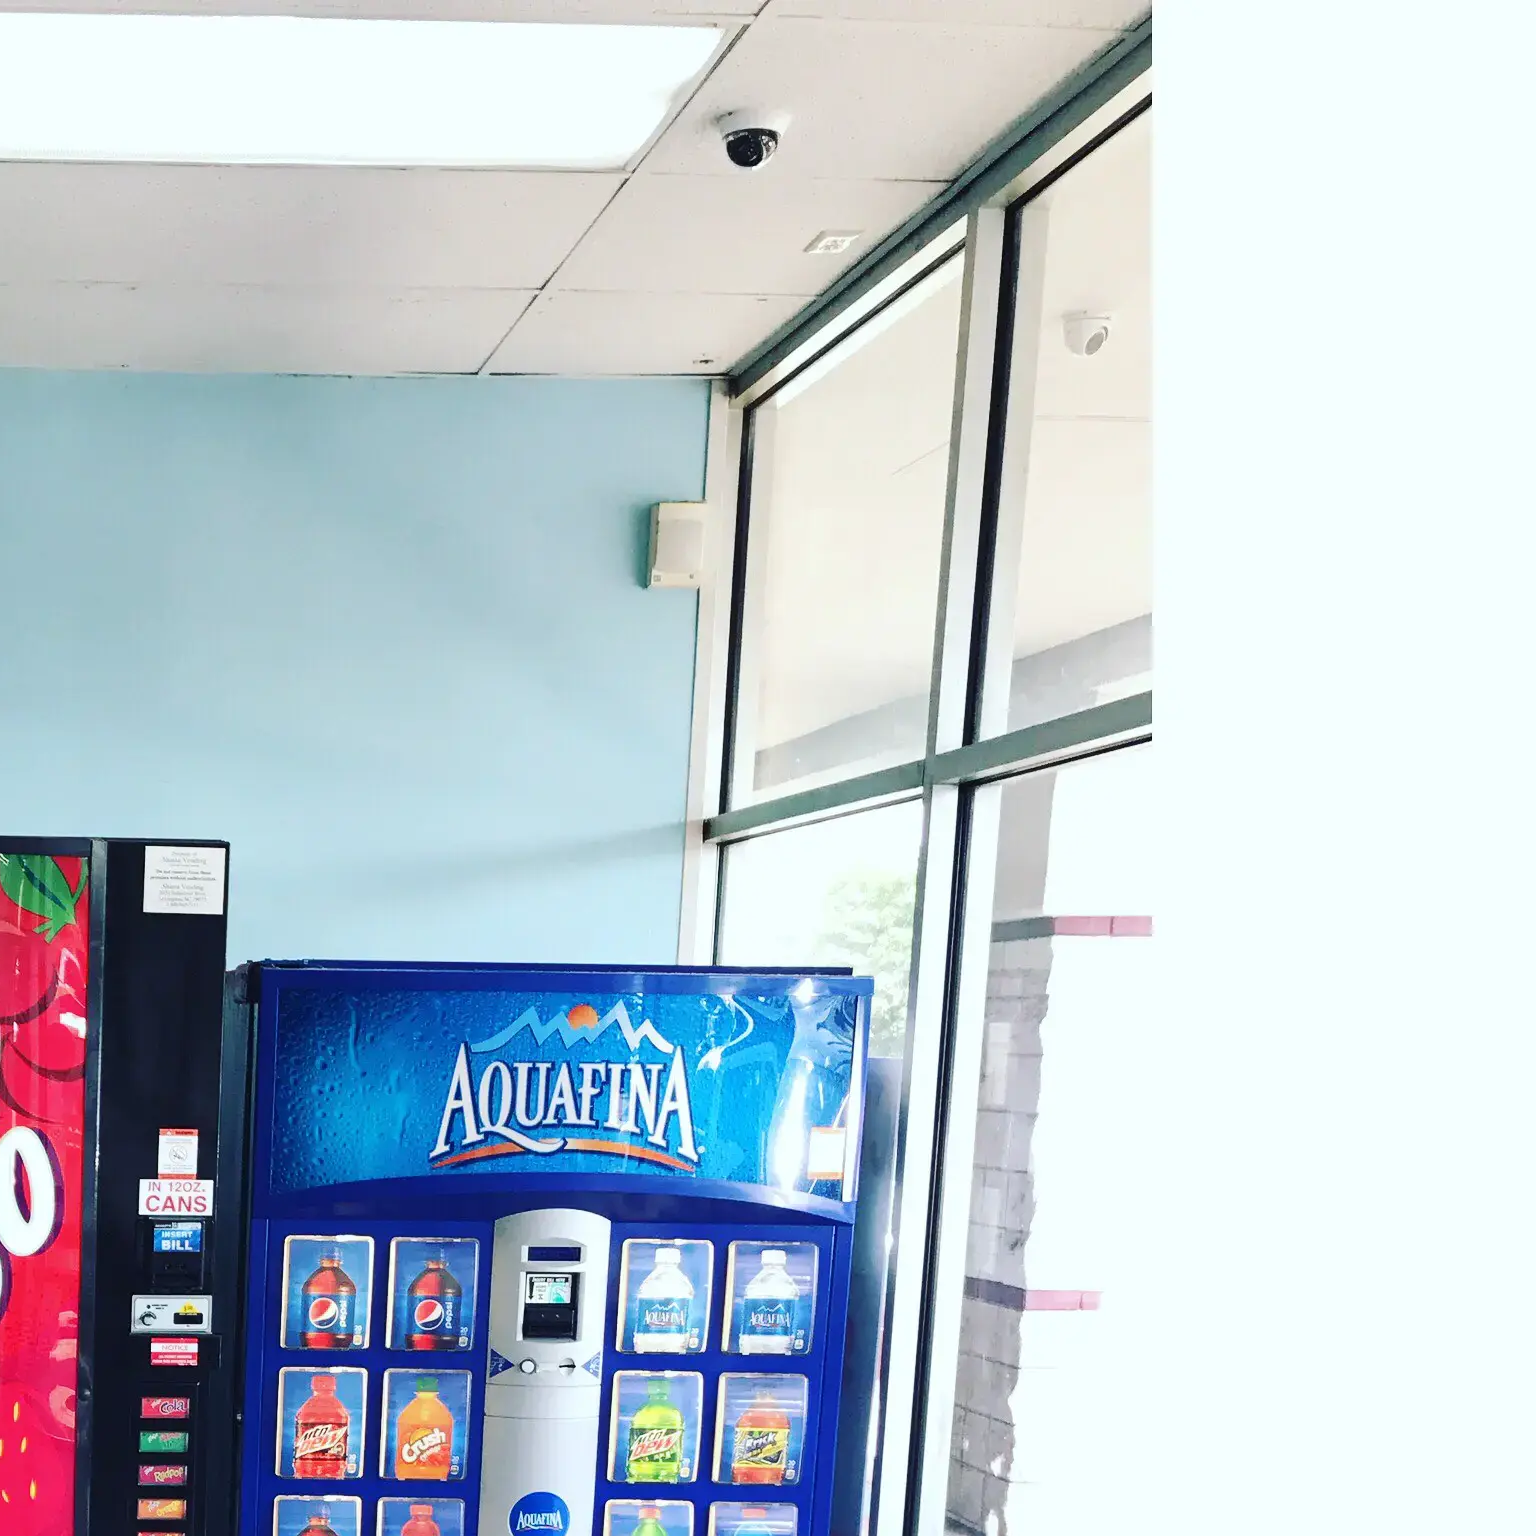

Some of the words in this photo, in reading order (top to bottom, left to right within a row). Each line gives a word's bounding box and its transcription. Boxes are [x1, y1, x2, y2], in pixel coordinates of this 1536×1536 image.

[429, 1040, 699, 1162] AQUAFINA
[148, 1181, 161, 1192] IN
[145, 1195, 207, 1213] CANS
[161, 1240, 192, 1251] BILL
[160, 1399, 186, 1415] Cola
[401, 1428, 446, 1464] Crush
[516, 1510, 564, 1531] AQUAFINA
